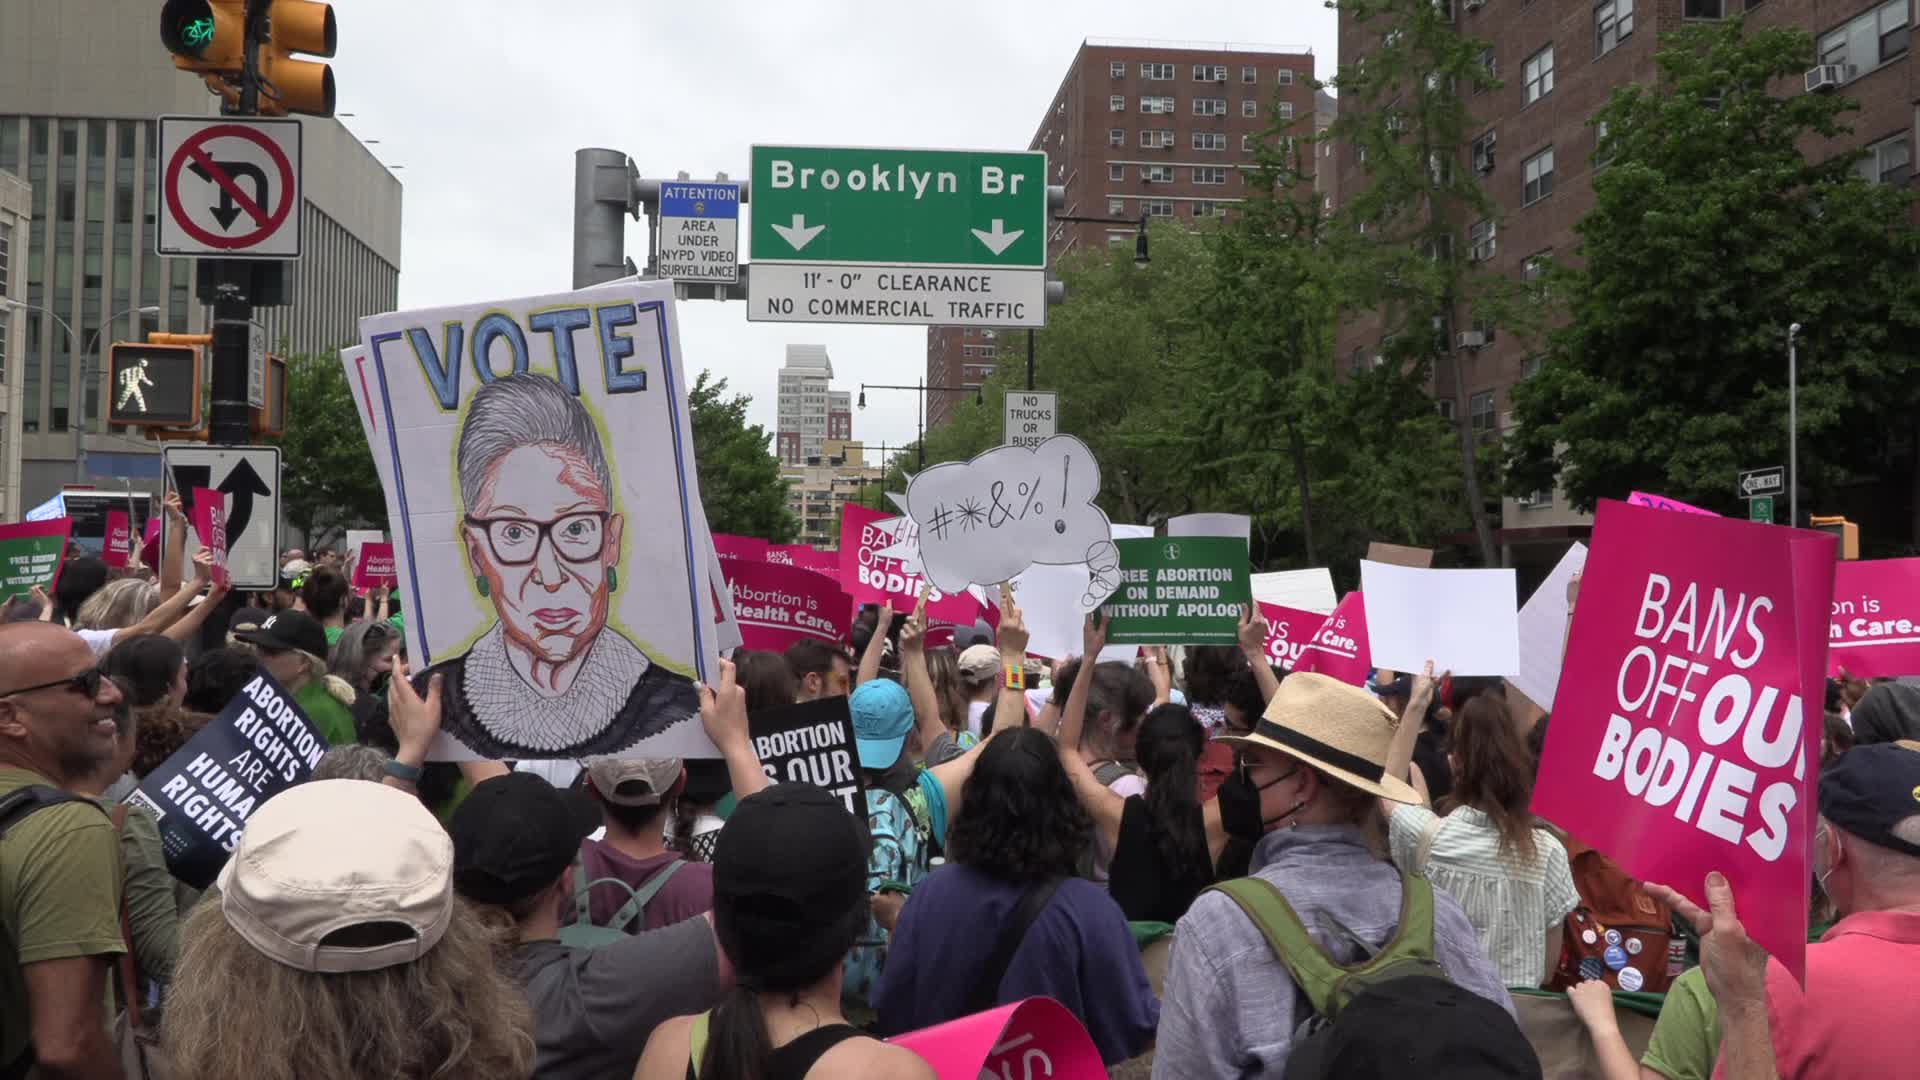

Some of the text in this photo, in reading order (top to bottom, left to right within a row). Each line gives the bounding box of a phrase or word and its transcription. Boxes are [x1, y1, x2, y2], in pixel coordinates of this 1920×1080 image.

[770, 160, 1024, 199] Brooklyn Br
[664, 187, 736, 201] ATTENTION
[681, 220, 716, 232] AREA
[678, 235, 719, 247] UNDER
[661, 249, 734, 262] NYPD VIDEO
[661, 264, 734, 278] SURVEILLANCE
[877, 274, 992, 293] CLEARANCE
[767, 298, 1025, 320] NO COMMERCIAL TRAFFIC
[404, 303, 648, 411] VOTE
[1023, 396, 1038, 407] NO
[1010, 409, 1052, 420] TRUCKS
[1023, 423, 1038, 433] OR
[1746, 477, 1777, 489] ONE WAY
[1119, 568, 1233, 583] REE ABORTION
[734, 584, 818, 610] Abortion is
[1126, 586, 1220, 600] ON DEMAND
[1862, 595, 1881, 613] is
[794, 610, 837, 633] Care.
[1634, 572, 1774, 669] BANS
[1849, 618, 1920, 637] Care.
[1321, 630, 1358, 651] Care.
[242, 675, 326, 771] ABORTION
[1616, 645, 1806, 783] OFF OU
[233, 707, 301, 783] RIGHTS
[228, 749, 275, 793] ARE
[786, 749, 855, 788] OUR
[185, 751, 256, 823] HUMA
[1592, 712, 1798, 863] BODIES
[160, 773, 243, 852] RIGHTS
